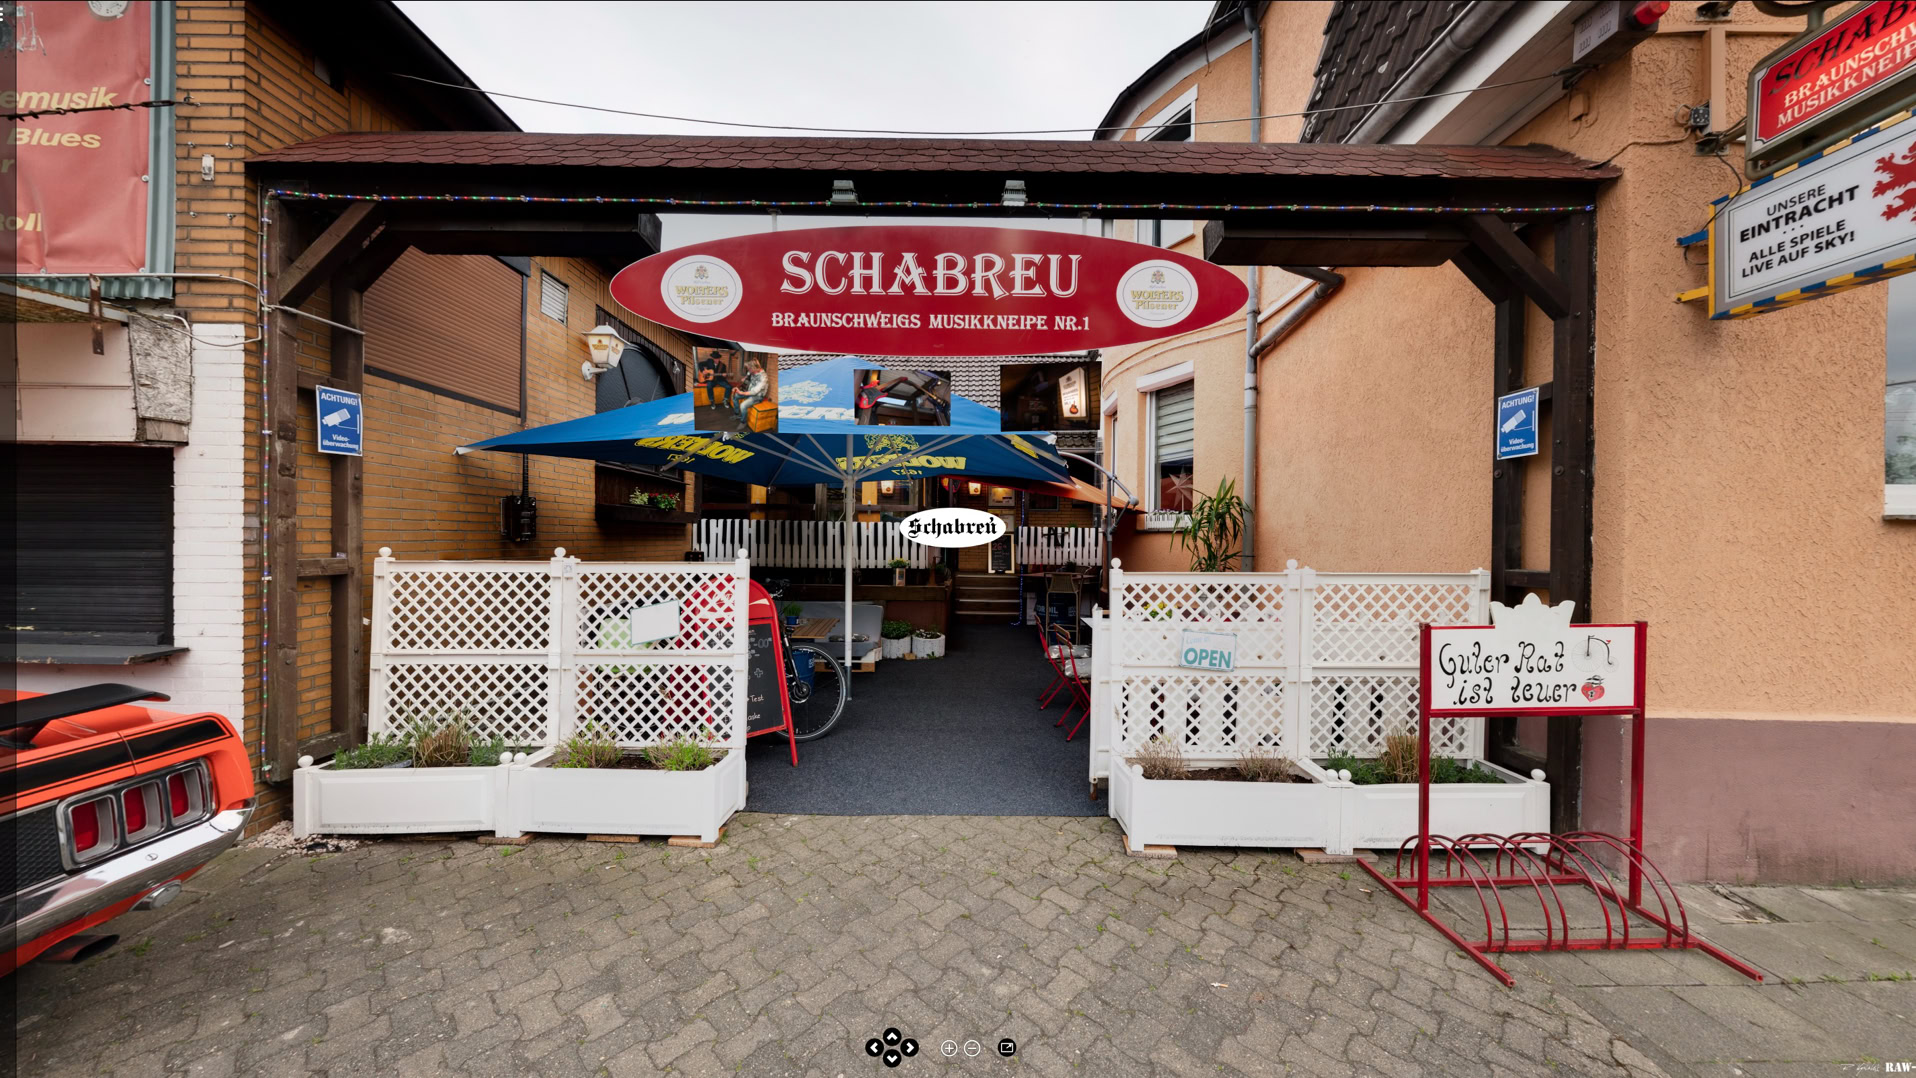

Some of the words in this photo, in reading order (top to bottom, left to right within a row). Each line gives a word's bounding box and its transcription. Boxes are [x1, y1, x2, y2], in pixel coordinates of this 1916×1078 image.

[1768, 0, 1916, 96] SCHAB
[0, 87, 118, 110] emusik
[7, 127, 101, 148] Blues
[1767, 184, 1826, 216] UNSERE
[1740, 185, 1859, 243] EINTRACHT
[1749, 241, 1785, 263] ALLE
[1790, 219, 1845, 248] SPIELE
[1742, 258, 1774, 278] LIVE
[1777, 246, 1809, 266] AUF
[1814, 230, 1855, 254] SKY!
[780, 250, 1082, 300] SCHABREU
[675, 285, 729, 297] WOLTERS
[1130, 290, 1184, 303] WOLTERS
[1135, 300, 1178, 310] Pilsener
[771, 311, 921, 329] BRAUNSCHWEIGS
[928, 314, 1048, 330] MUSIKKNEIPE
[1053, 315, 1090, 331] NR.1
[321, 392, 358, 406] ACHTUNG!
[1502, 395, 1535, 409] ACHTUNG!
[1184, 648, 1231, 668] OPEN
[1439, 641, 1510, 688] Guter
[1514, 641, 1565, 673] Rat
[1453, 677, 1493, 705] ist
[1510, 676, 1577, 703] teuer
[748, 712, 760, 720] aske
